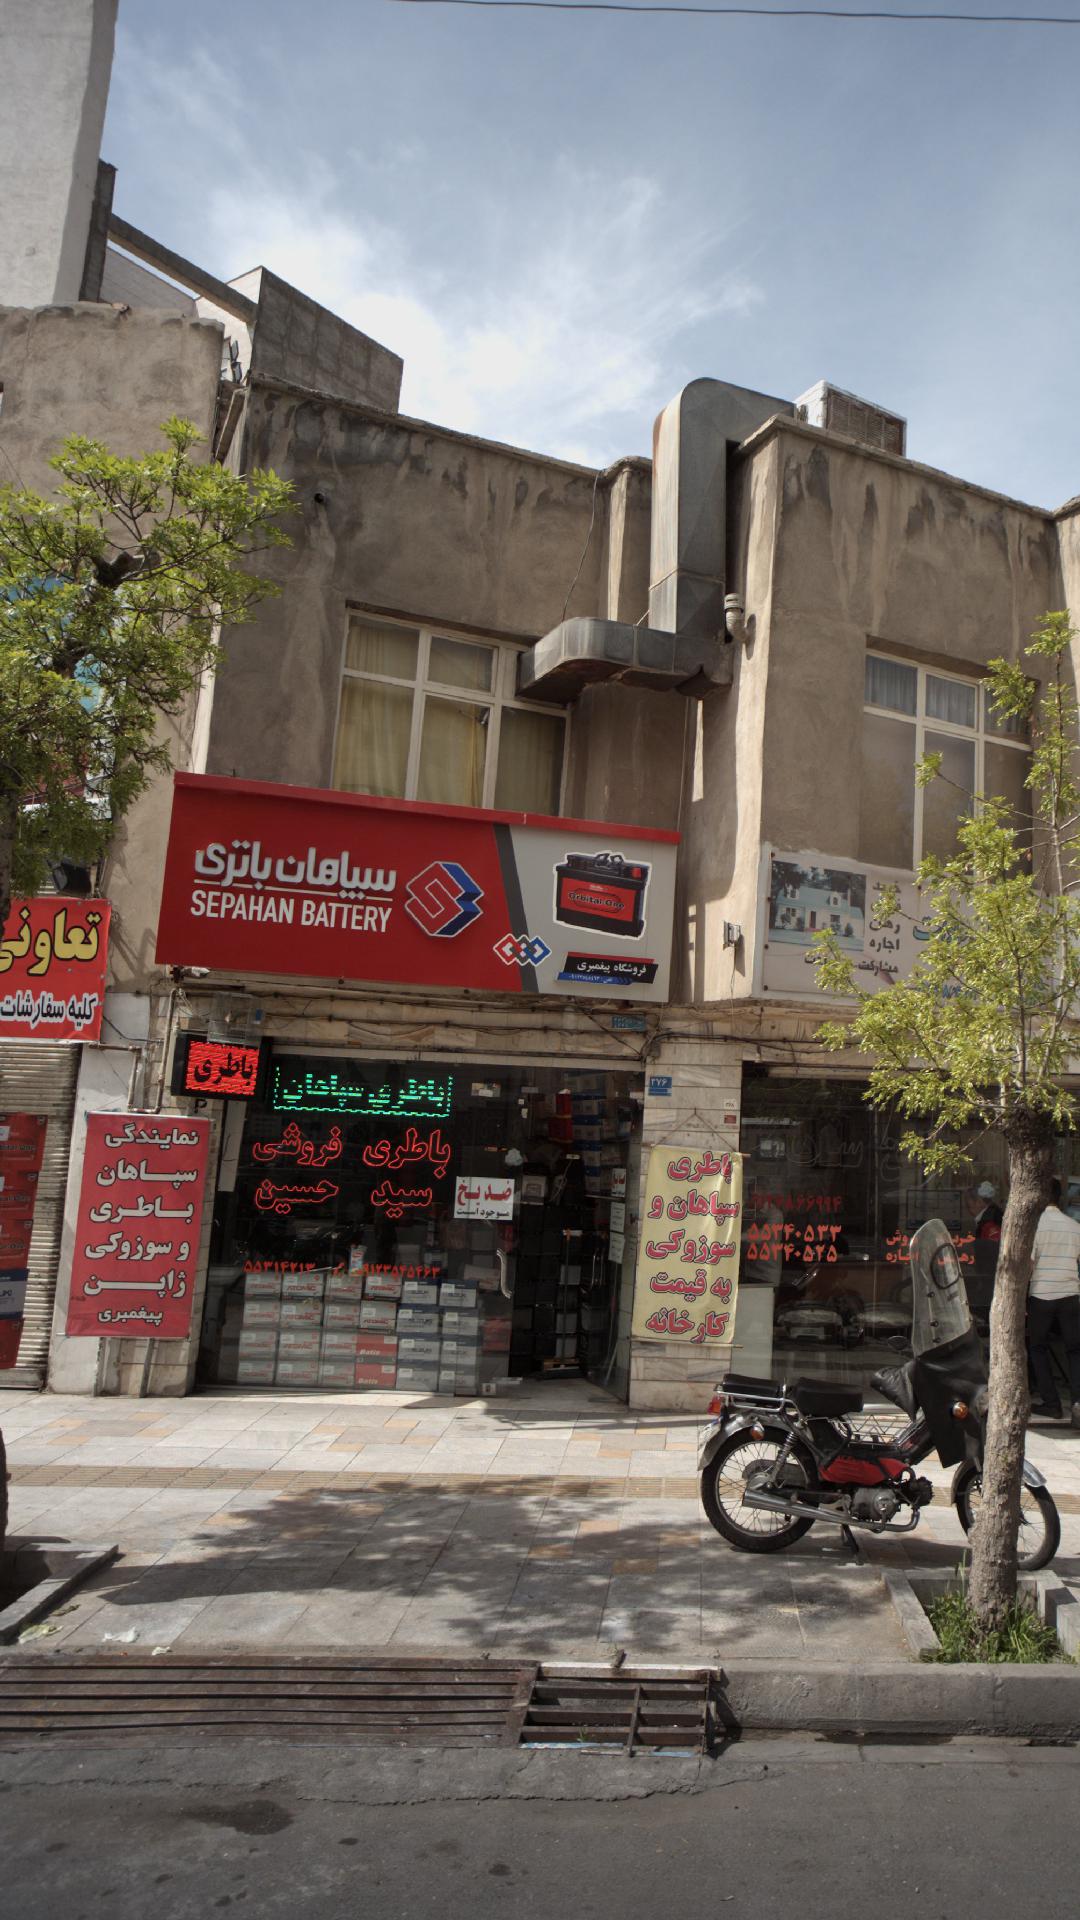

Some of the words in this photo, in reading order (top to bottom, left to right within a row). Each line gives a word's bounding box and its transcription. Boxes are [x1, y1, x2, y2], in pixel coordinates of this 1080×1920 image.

[194, 840, 272, 891] باتری
[275, 846, 397, 900] سپاهان
[190, 889, 295, 925] SEPAHAN
[301, 899, 393, 933] BATTERY
[869, 937, 900, 953] اجاره
[576, 961, 611, 975] پیغمبری
[613, 963, 647, 977] فروشگاه
[0, 991, 65, 1026] سفارشات
[67, 994, 98, 1028] کلیه
[194, 1052, 254, 1087] باطری
[104, 1122, 200, 1150] نمایندگی
[252, 1122, 343, 1167] فروشی
[362, 1127, 451, 1180] باطری
[667, 1150, 733, 1184] باطری
[96, 1158, 199, 1190] سپاهان
[255, 1178, 339, 1215] حسین
[370, 1180, 433, 1219] سید
[484, 1180, 512, 1201] ضد
[89, 1194, 195, 1225] باطری
[647, 1195, 664, 1219] و
[667, 1188, 741, 1227] سپاهان
[84, 1231, 173, 1262] سوزوکی
[646, 1228, 737, 1265] سوزوکی
[747, 1223, 842, 1242] ۵۵۳۴۰۵۳۳
[176, 1241, 190, 1262] و
[746, 1242, 838, 1262] ۵۵۳۴۰۵۲۵
[83, 1267, 187, 1299] ژاپن
[650, 1268, 707, 1303] قیمت
[710, 1276, 733, 1305] به
[97, 1306, 163, 1328] پیغمبری
